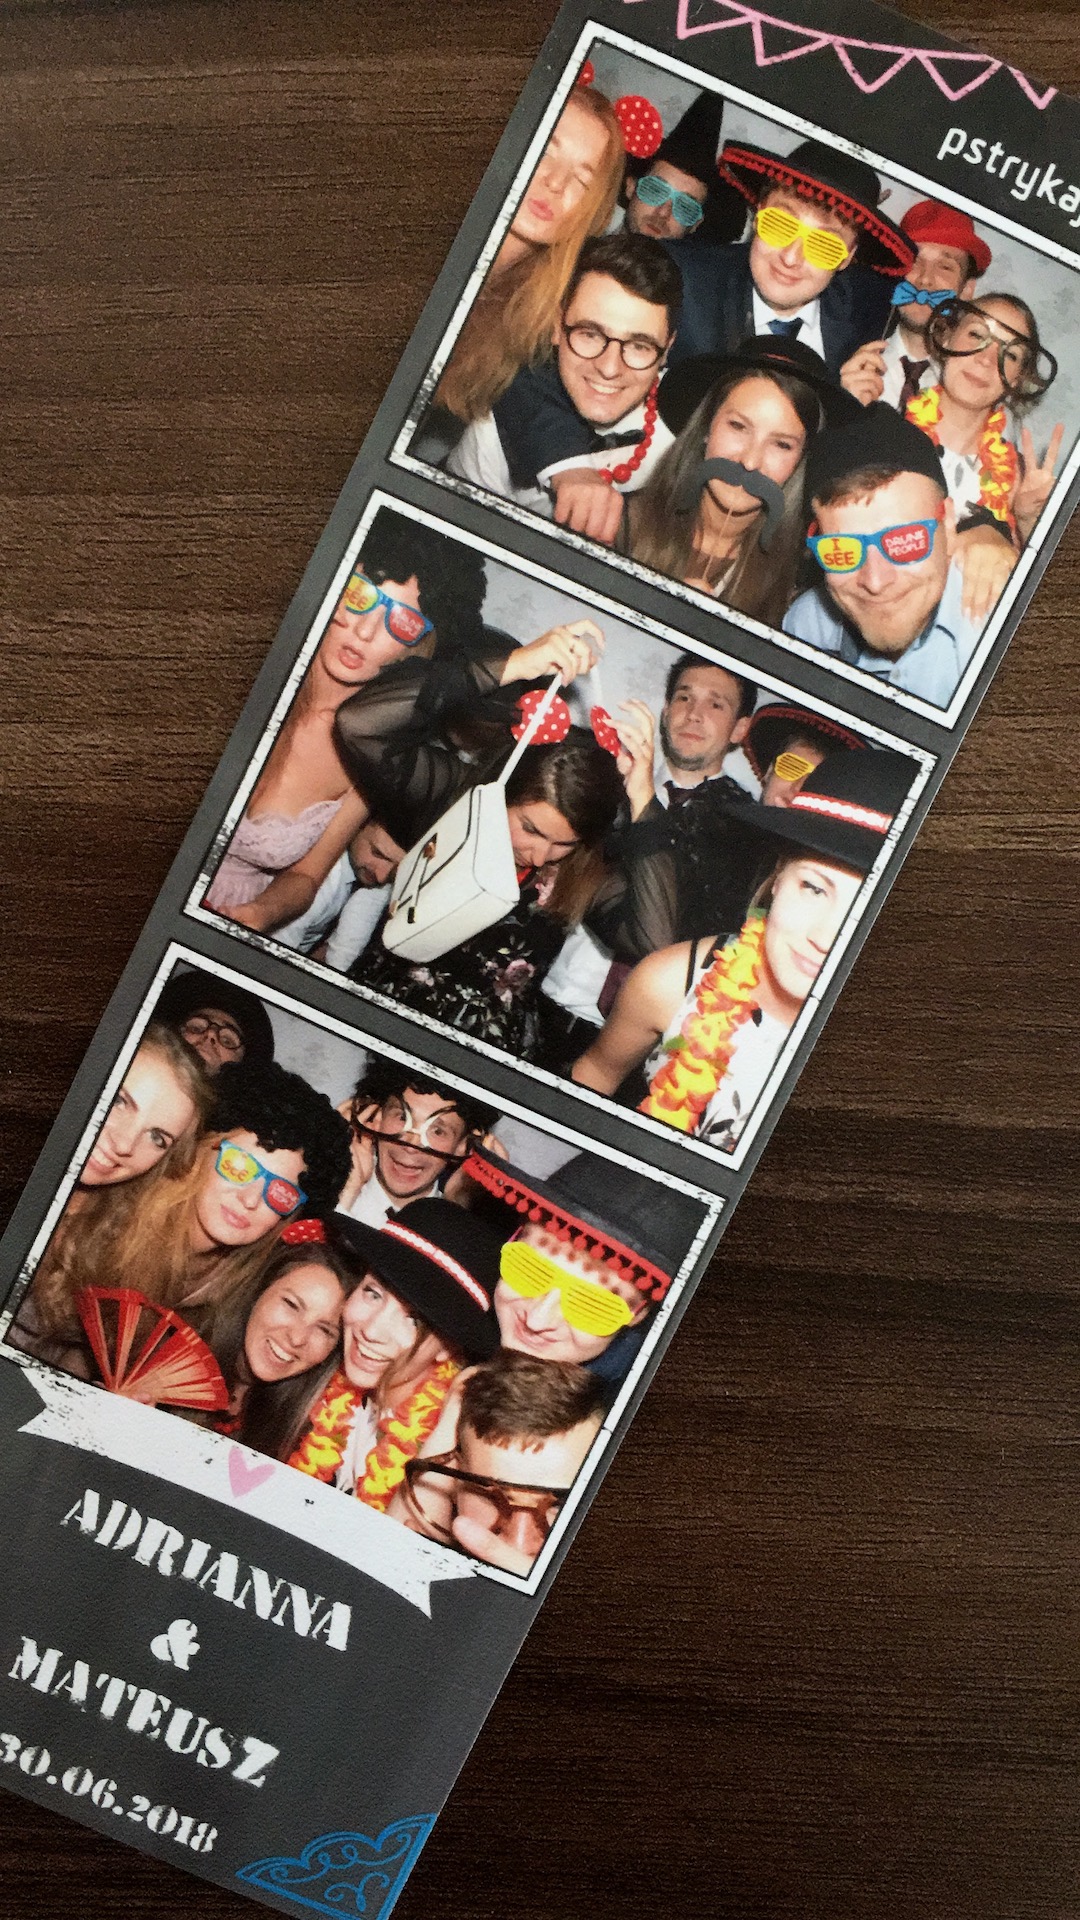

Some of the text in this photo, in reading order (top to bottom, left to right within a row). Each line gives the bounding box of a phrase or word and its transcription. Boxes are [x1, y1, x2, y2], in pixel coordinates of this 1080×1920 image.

[831, 538, 841, 551] I
[884, 529, 926, 546] DRUNK
[887, 541, 926, 556] PEOPLE
[823, 551, 855, 566] SEE
[60, 1488, 353, 1652] ADRIANNA
[149, 1618, 201, 1671] &
[7, 1635, 281, 1789] MATEUSZ
[0, 1731, 219, 1854] 30.06.2018
